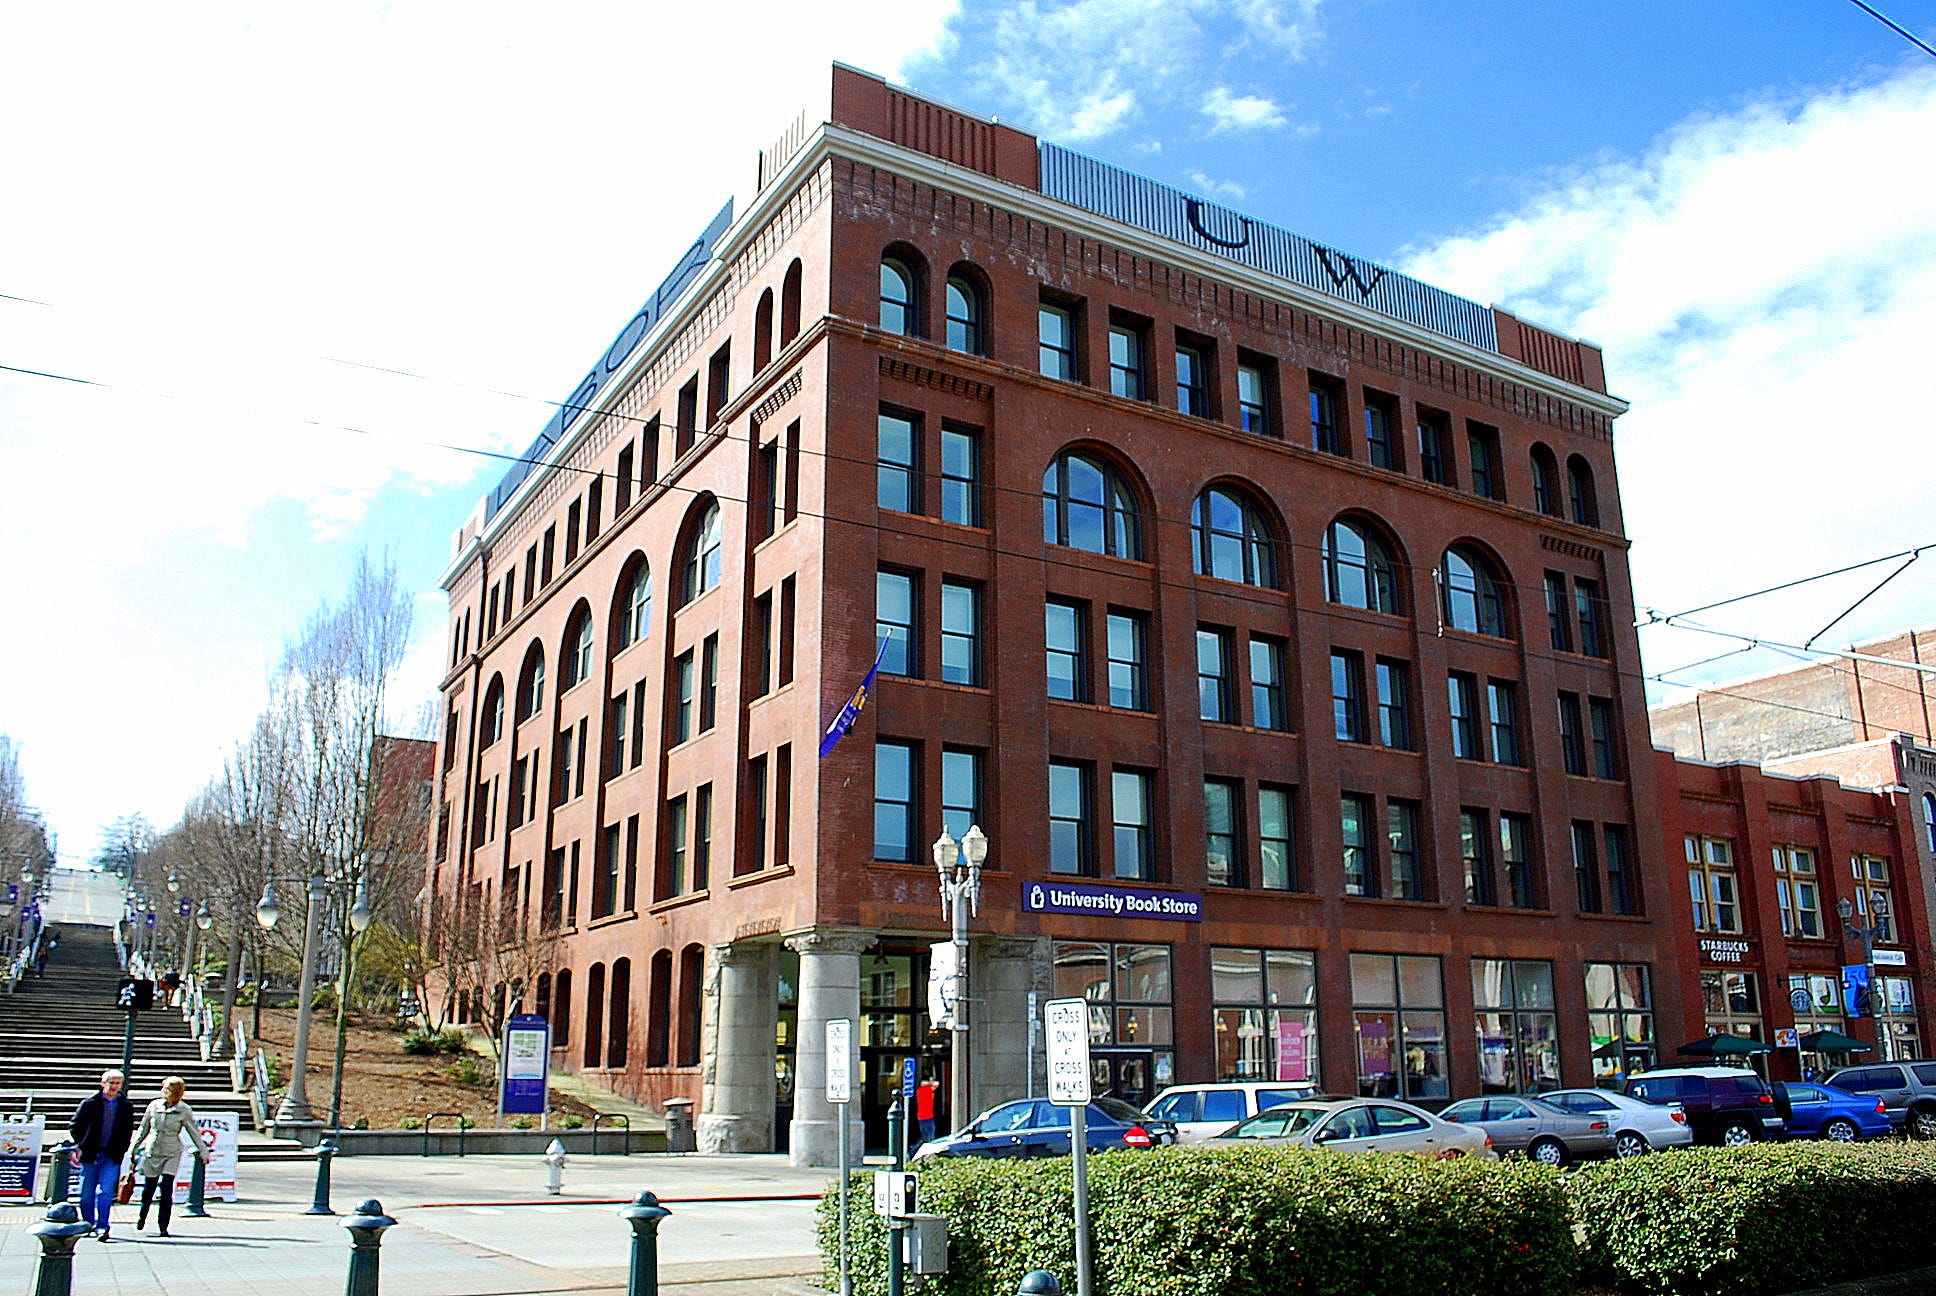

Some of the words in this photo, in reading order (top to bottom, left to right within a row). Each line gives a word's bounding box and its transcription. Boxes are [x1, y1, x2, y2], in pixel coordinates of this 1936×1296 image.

[1050, 890, 1124, 914] University
[1126, 895, 1161, 913] Book
[1162, 898, 1198, 915] Store
[1700, 939, 1749, 952] STARBUCKS
[1710, 950, 1741, 962] COFFEE
[1052, 1010, 1080, 1024] CROSS
[1056, 1030, 1078, 1043] ONLY
[1054, 1062, 1083, 1074] CROSS
[1056, 1080, 1084, 1093] WALKS
